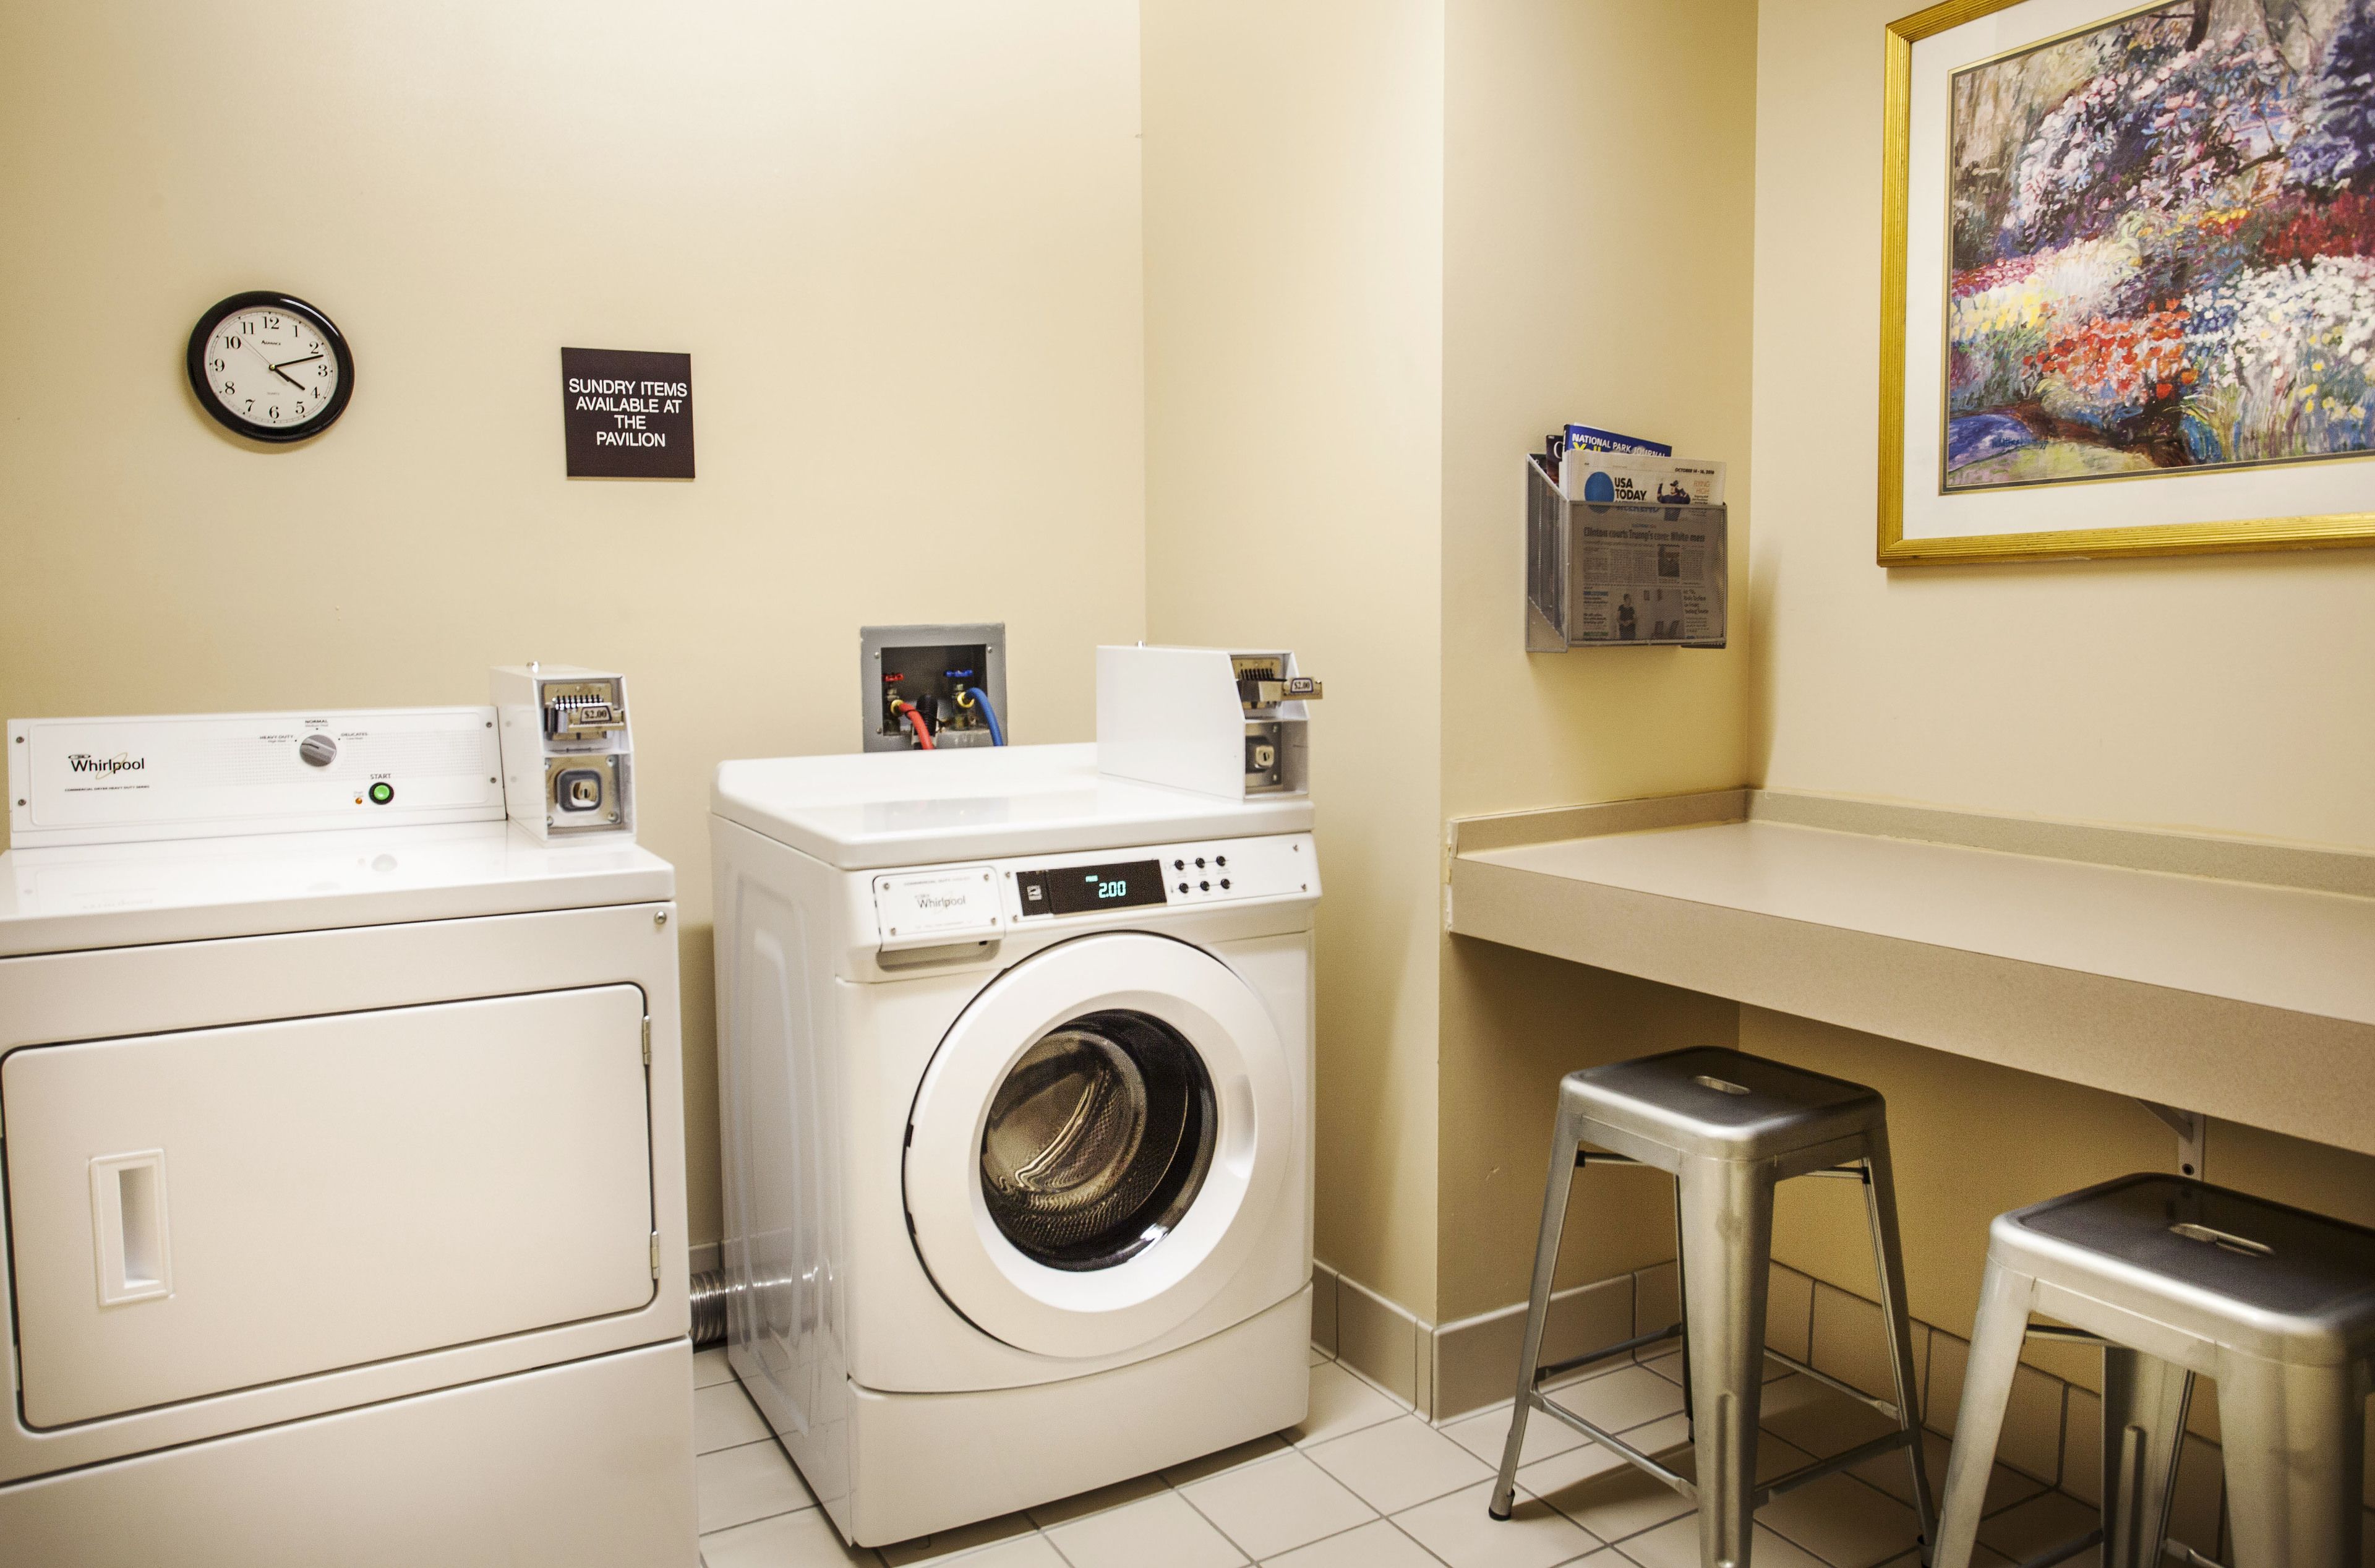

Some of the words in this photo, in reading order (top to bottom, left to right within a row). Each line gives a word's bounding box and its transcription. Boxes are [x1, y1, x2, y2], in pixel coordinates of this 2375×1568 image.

[241, 322, 254, 335] 11
[263, 316, 280, 329] 12
[293, 325, 298, 337] 1
[225, 336, 241, 349] 10
[309, 341, 319, 354] 2
[214, 359, 225, 372] 9
[318, 365, 328, 377] 3
[225, 381, 235, 395] 8
[310, 386, 320, 399] 4
[568, 378, 636, 395] SUNDRY
[641, 381, 688, 397] ITEMS
[246, 399, 255, 412] 7
[295, 401, 305, 414] 5
[576, 396, 659, 413] AVAILABLE
[664, 400, 682, 414] AT
[269, 405, 280, 419] 6
[614, 414, 647, 430] THE
[596, 431, 665, 447] PAVILION
[1572, 434, 1611, 448] NATIONAL
[1612, 442, 1632, 453] PARK
[1614, 478, 1633, 489] USA
[1615, 489, 1647, 501] TODAY
[584, 710, 607, 719] $2.00
[71, 758, 145, 774] Whirlpool
[1098, 880, 1126, 898] 2.00
[917, 896, 965, 908] Whirlpool
